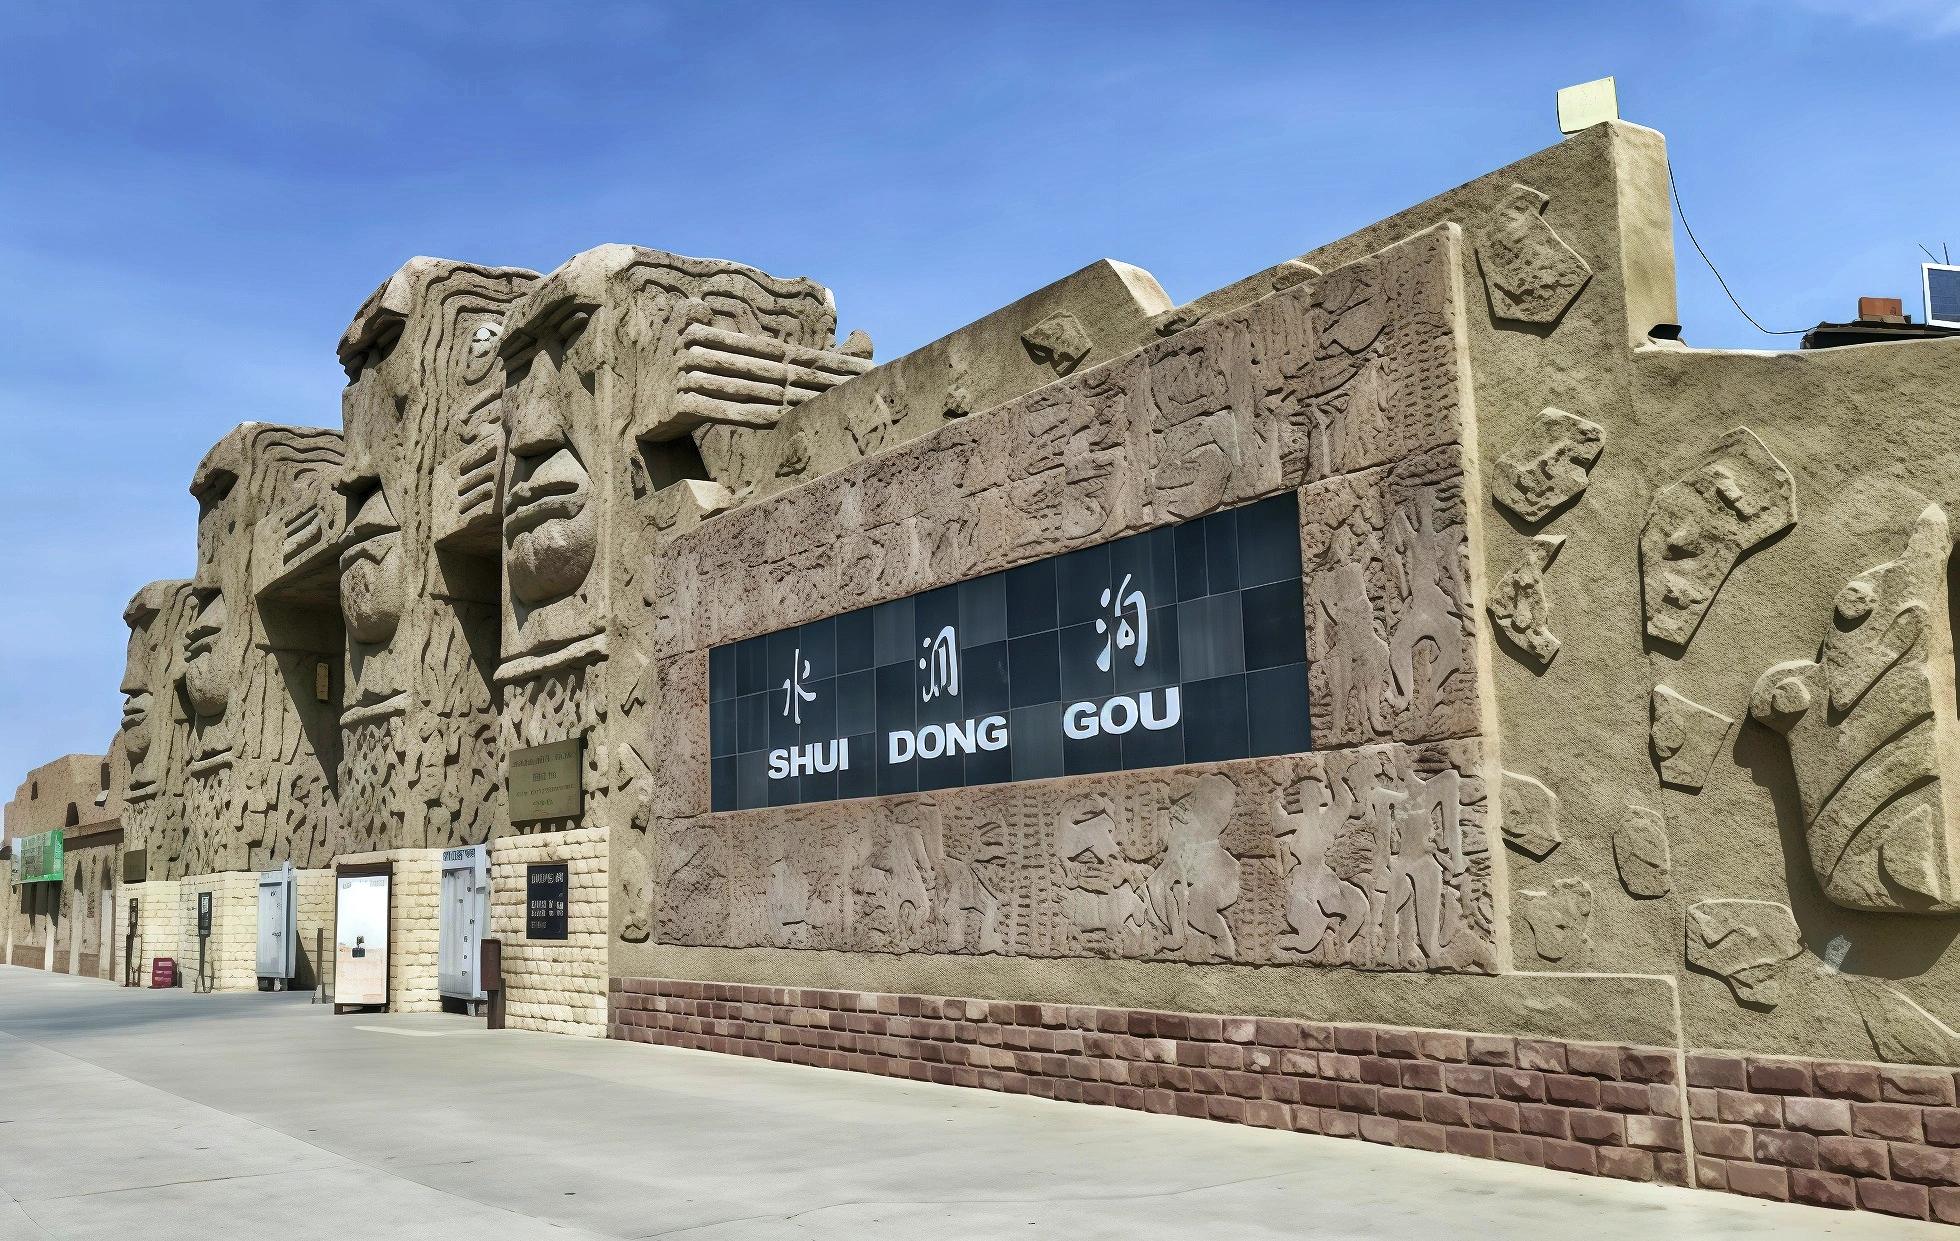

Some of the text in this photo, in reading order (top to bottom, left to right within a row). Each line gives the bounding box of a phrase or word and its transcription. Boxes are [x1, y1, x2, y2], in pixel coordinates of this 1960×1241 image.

[768, 686, 1181, 779] SHUI DONG GOU
